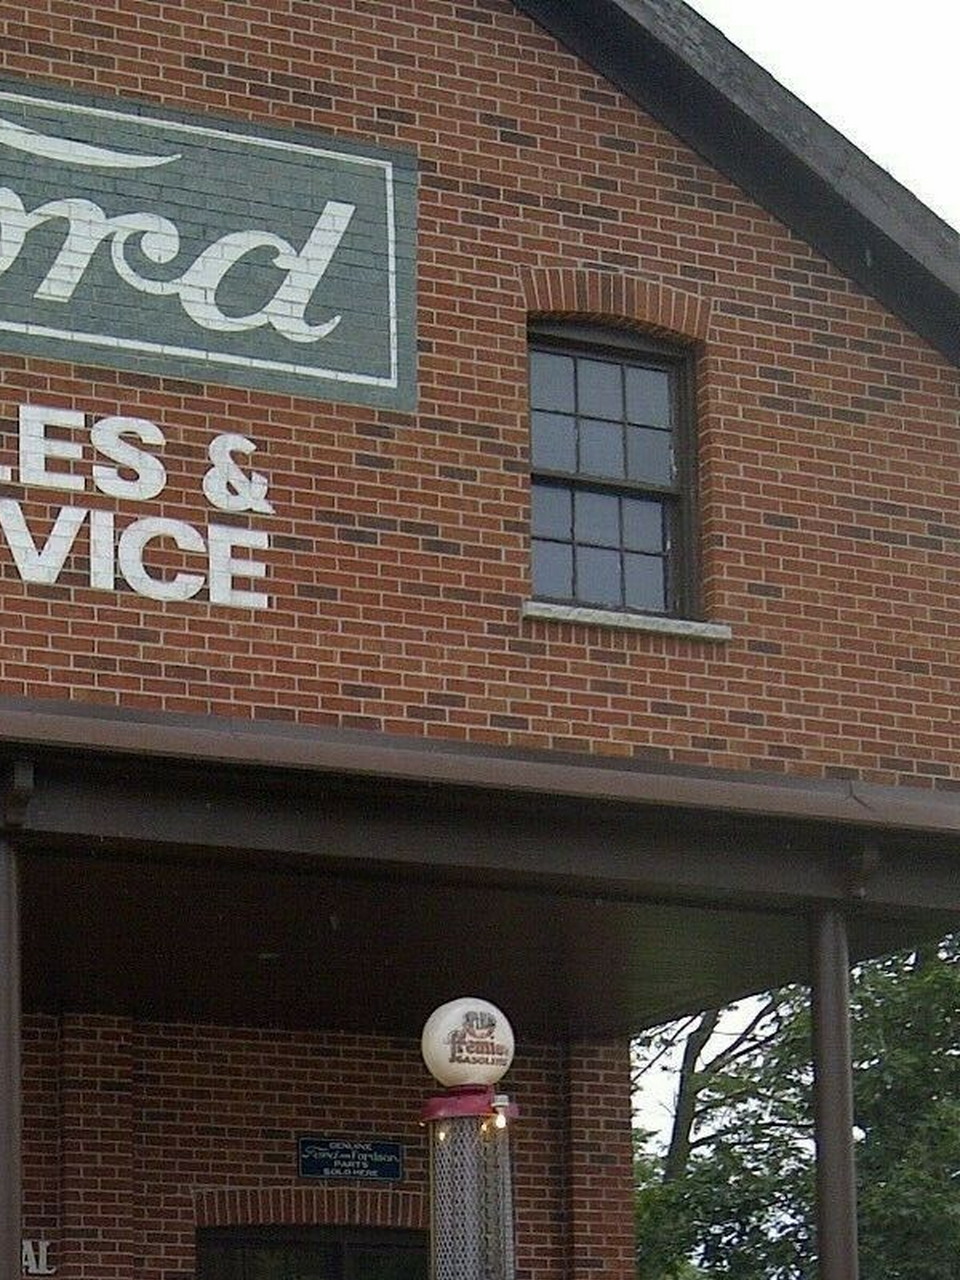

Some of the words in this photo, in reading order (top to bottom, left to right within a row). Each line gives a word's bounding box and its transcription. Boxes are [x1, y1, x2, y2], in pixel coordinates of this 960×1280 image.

[202, 432, 275, 515] &
[333, 1160, 369, 1169] PARTS
[323, 1167, 351, 1176] SOLD
